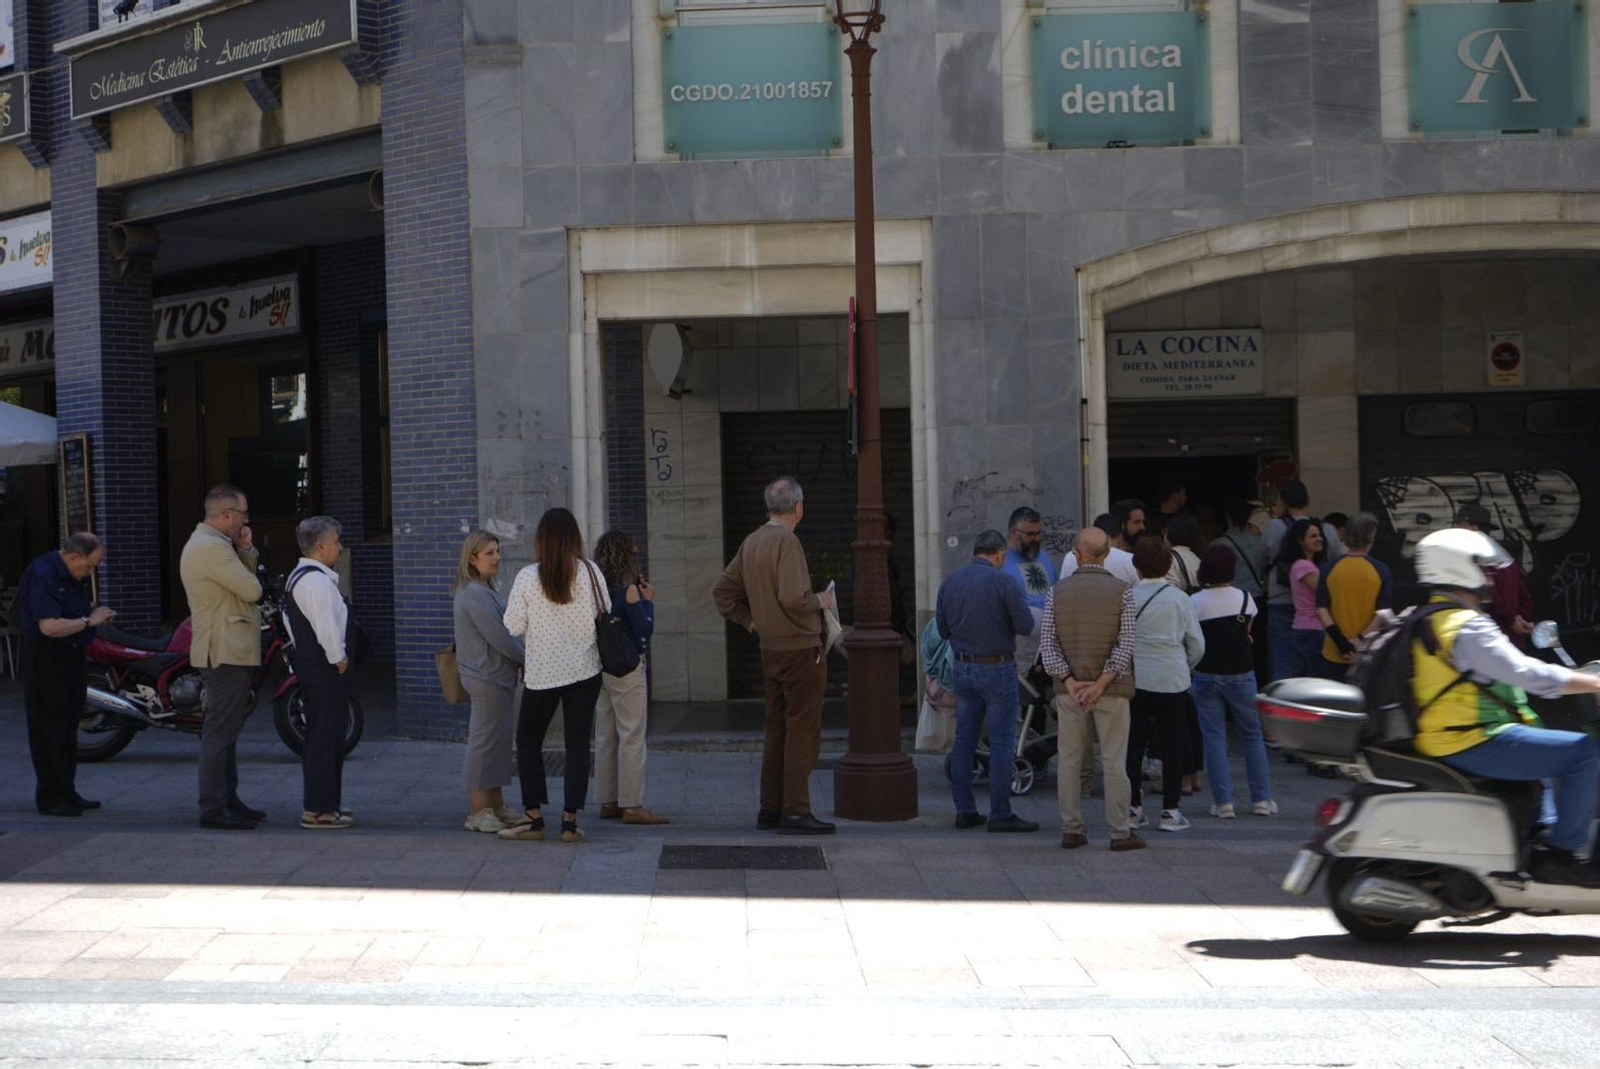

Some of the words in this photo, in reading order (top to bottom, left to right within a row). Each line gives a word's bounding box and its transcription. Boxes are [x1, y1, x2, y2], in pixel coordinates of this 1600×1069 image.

[89, 71, 147, 100] Medicina
[148, 56, 199, 84] Estética
[215, 18, 326, 66] Antienvejecimiento
[1060, 39, 1182, 71] clínica
[670, 81, 833, 102] CGDO.21001857
[1060, 82, 1177, 115] dental
[249, 285, 291, 319] huelva
[1116, 338, 1148, 356] LA
[1160, 335, 1259, 355] COCINA
[1123, 361, 1157, 371] DIETA
[1162, 359, 1256, 371] MEDITERRANEA
[1140, 375, 1174, 384] COMIDA
[1178, 375, 1199, 383] PARA
[1203, 374, 1236, 382] LLEVAR
